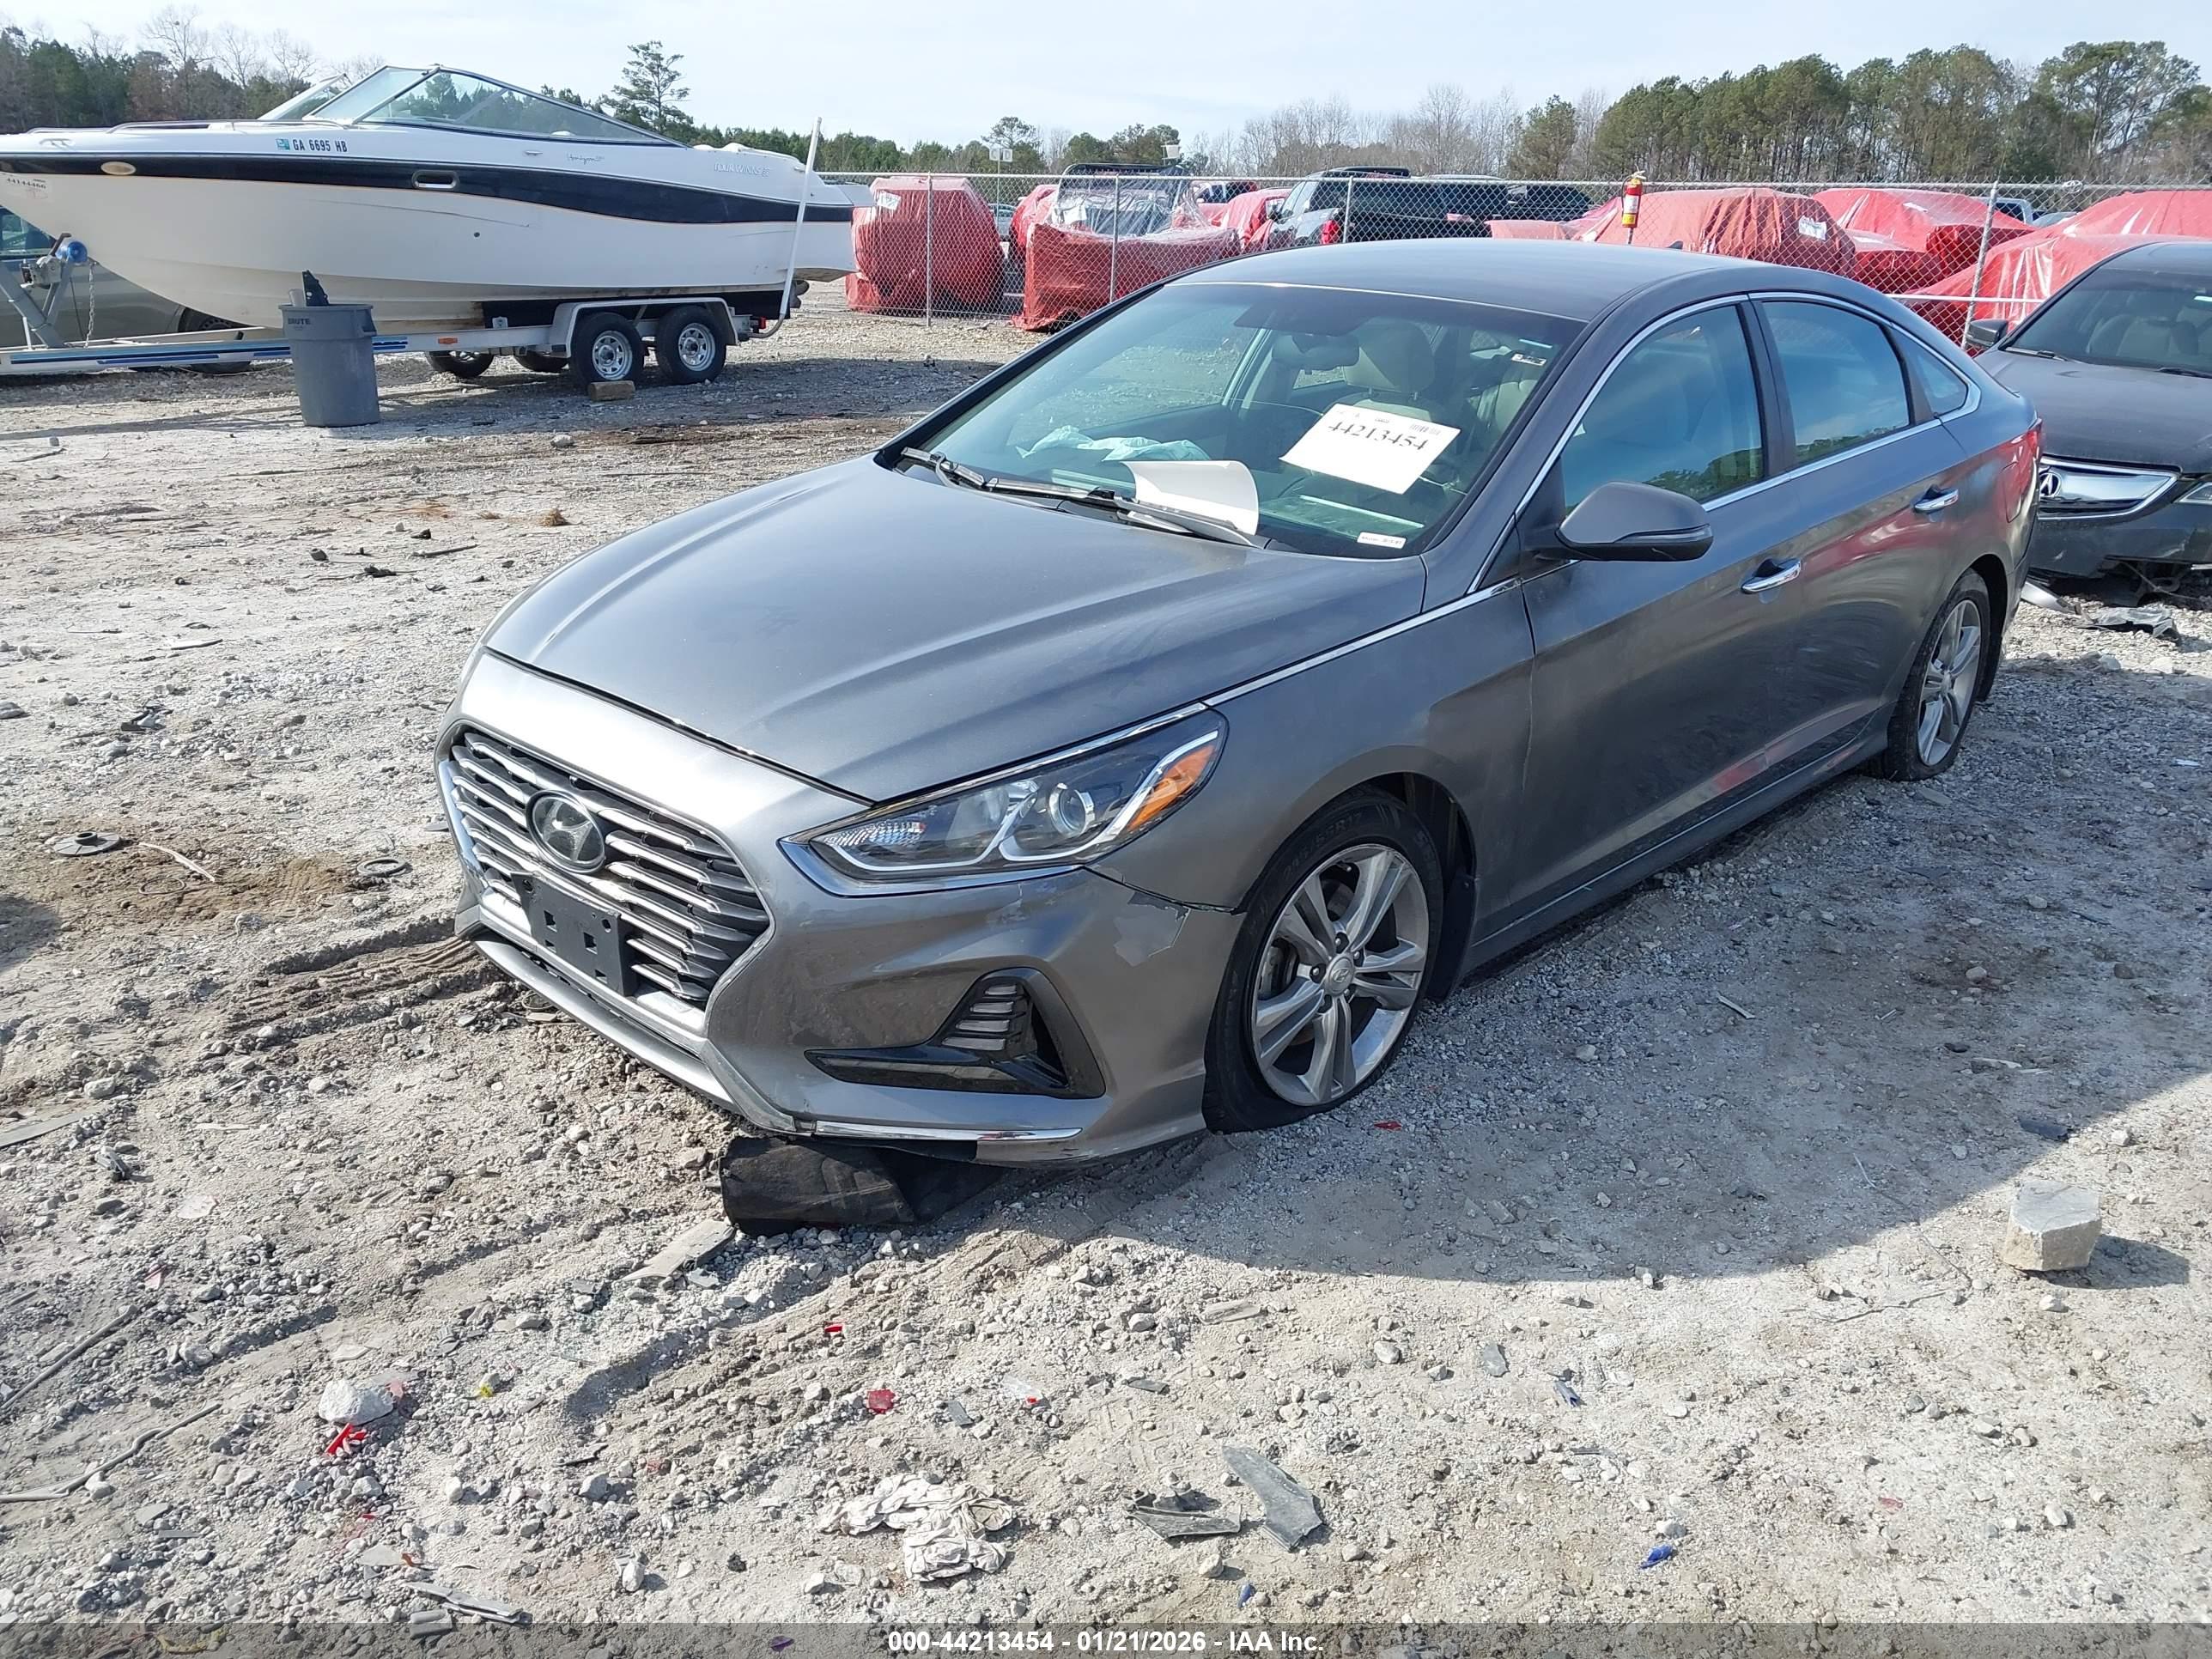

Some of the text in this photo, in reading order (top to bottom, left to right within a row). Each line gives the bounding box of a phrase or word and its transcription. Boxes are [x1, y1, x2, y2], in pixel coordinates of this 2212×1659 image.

[292, 139, 348, 153] GA 6695 HB
[1328, 421, 1429, 451] 44213454
